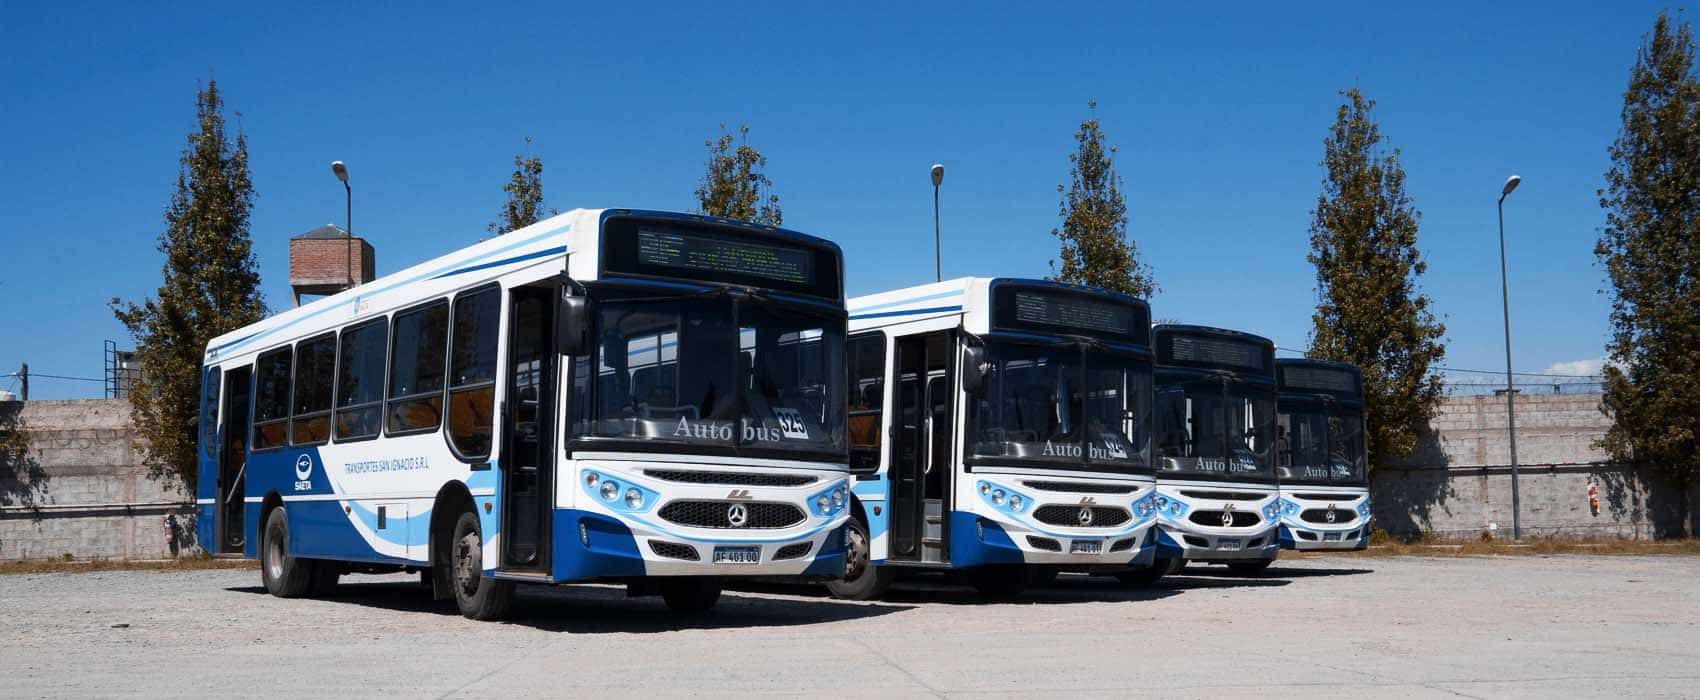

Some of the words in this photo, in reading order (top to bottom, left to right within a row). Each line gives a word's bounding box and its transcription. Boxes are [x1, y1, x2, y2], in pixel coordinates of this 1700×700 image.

[673, 415, 734, 441] Auto
[741, 418, 781, 442] bus
[777, 411, 806, 433] 325
[1042, 439, 1083, 457] Auto
[344, 461, 379, 474] TRANSPORTES
[379, 460, 390, 472] SAN
[391, 457, 414, 472] IGNACIO
[1195, 456, 1226, 472] Auto
[1304, 465, 1328, 479] Auto
[294, 480, 312, 491] SAETA
